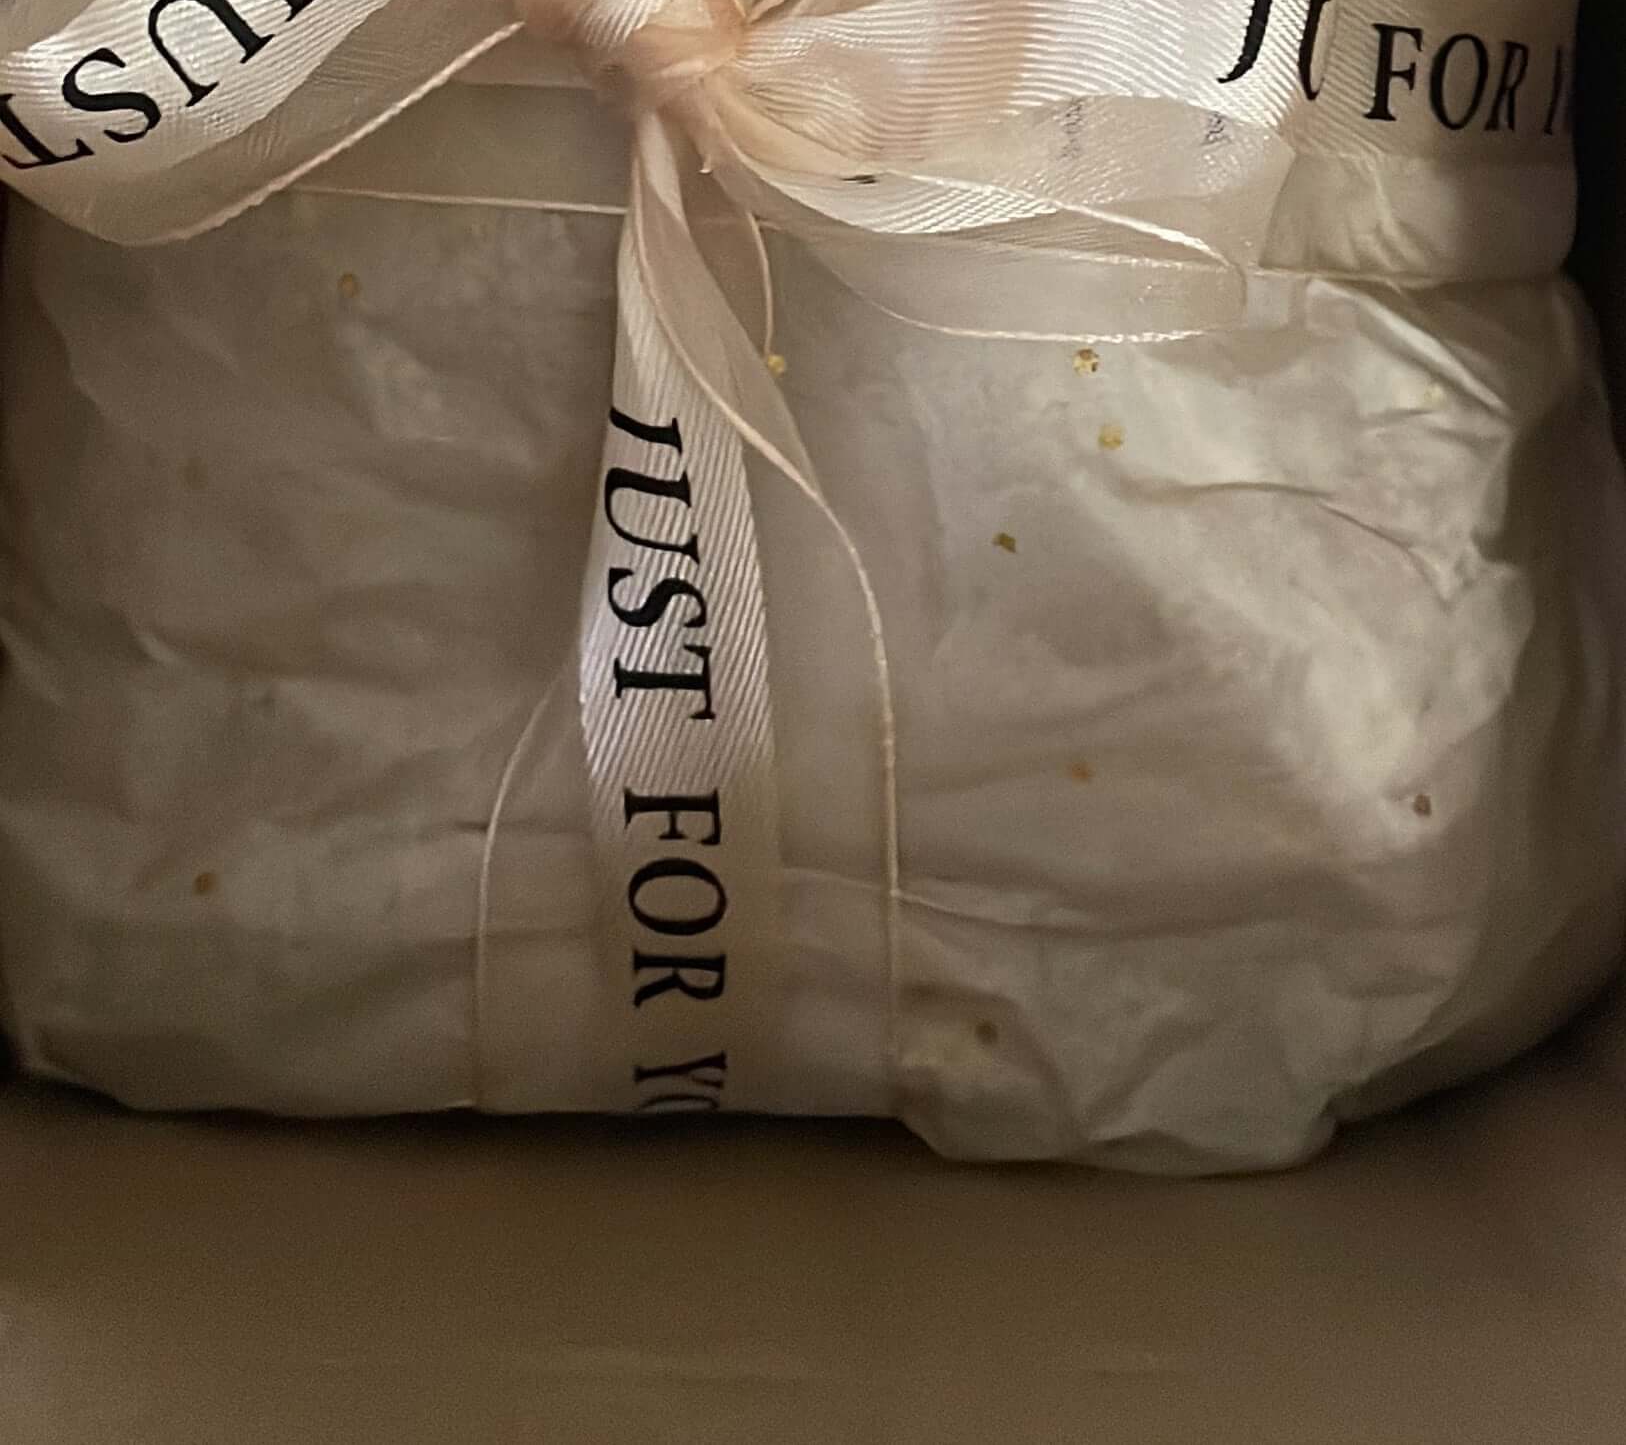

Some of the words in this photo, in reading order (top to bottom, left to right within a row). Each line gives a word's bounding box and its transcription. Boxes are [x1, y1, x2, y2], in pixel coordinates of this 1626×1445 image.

[1363, 22, 1530, 133] FOR
[603, 405, 716, 721] JUST
[622, 786, 728, 1010] FOR
